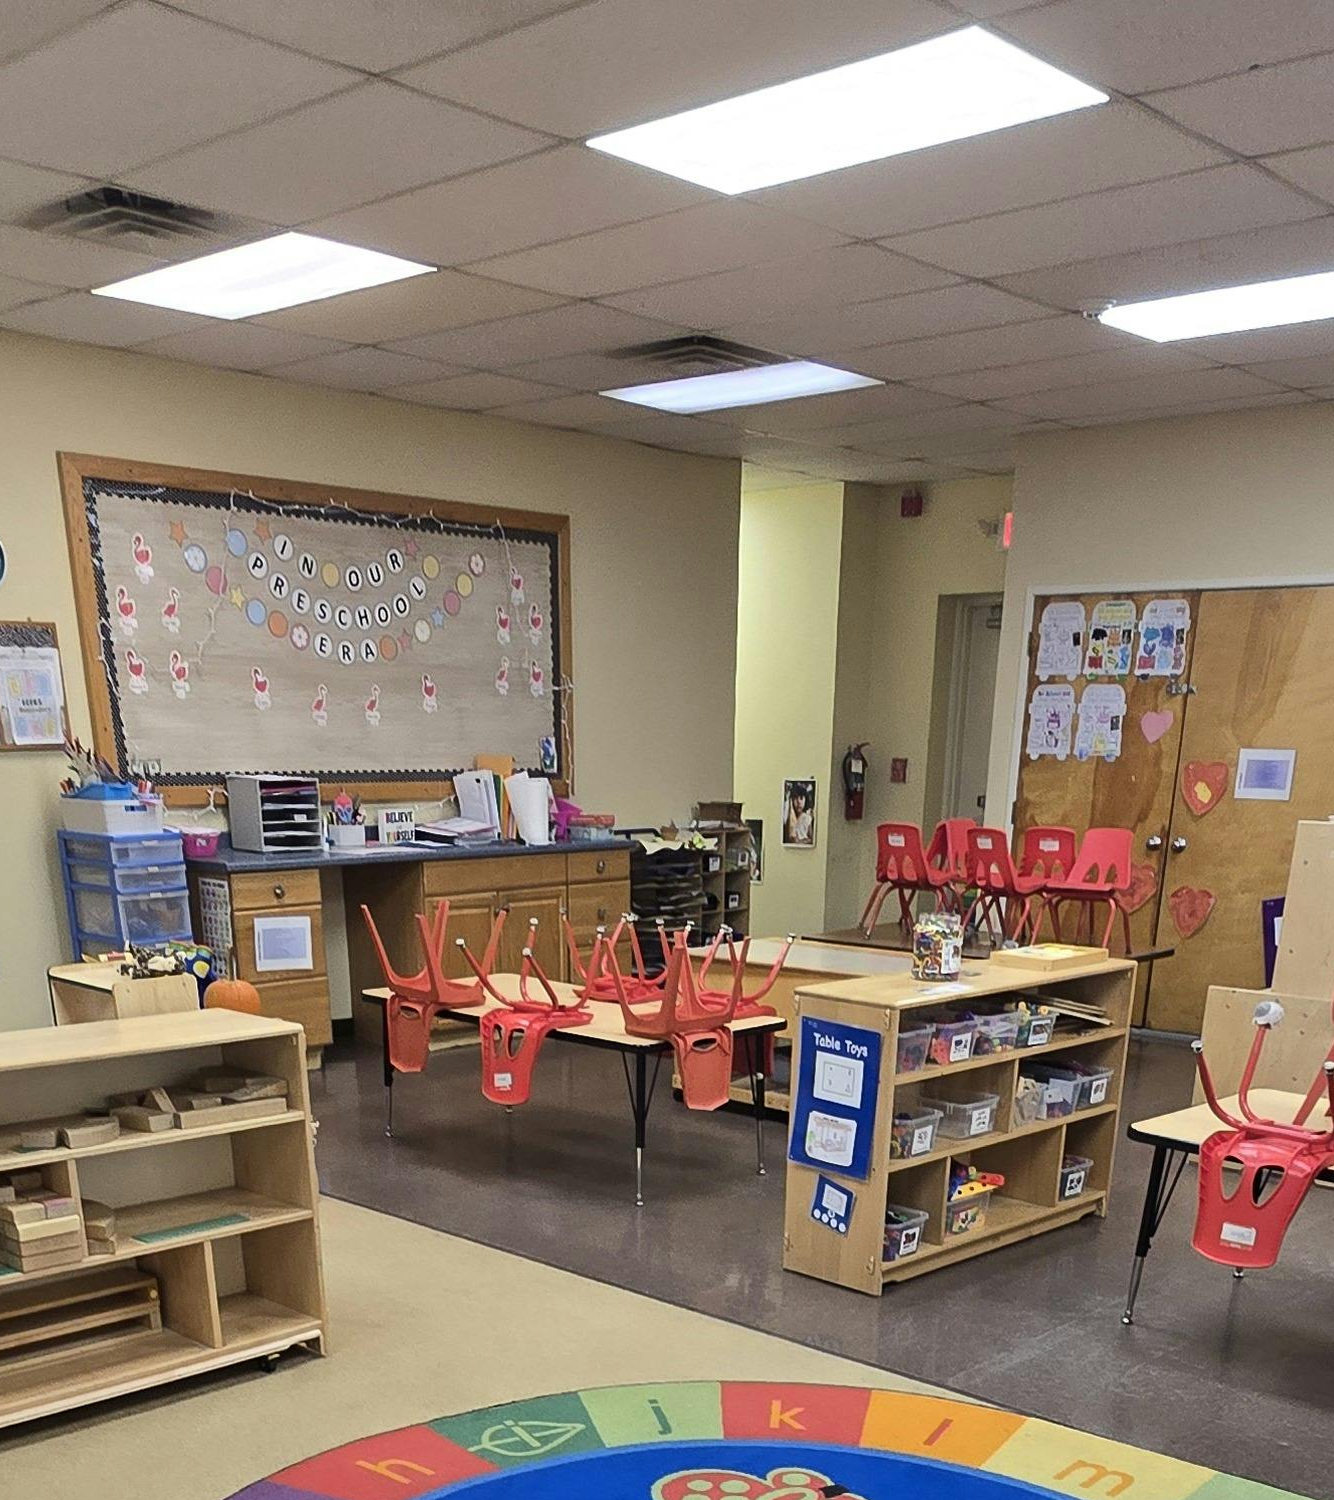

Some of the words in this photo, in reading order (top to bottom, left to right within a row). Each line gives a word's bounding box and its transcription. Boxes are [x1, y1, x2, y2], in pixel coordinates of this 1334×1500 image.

[280, 539, 314, 575] IN
[347, 552, 401, 587] OUR
[251, 556, 424, 627] PRESCHOOL
[319, 637, 376, 661] ERA
[813, 1032, 842, 1051] Table
[844, 1039, 869, 1059] Toys
[769, 1400, 805, 1430] k
[355, 1455, 437, 1486] h
[1055, 1459, 1136, 1499] m
